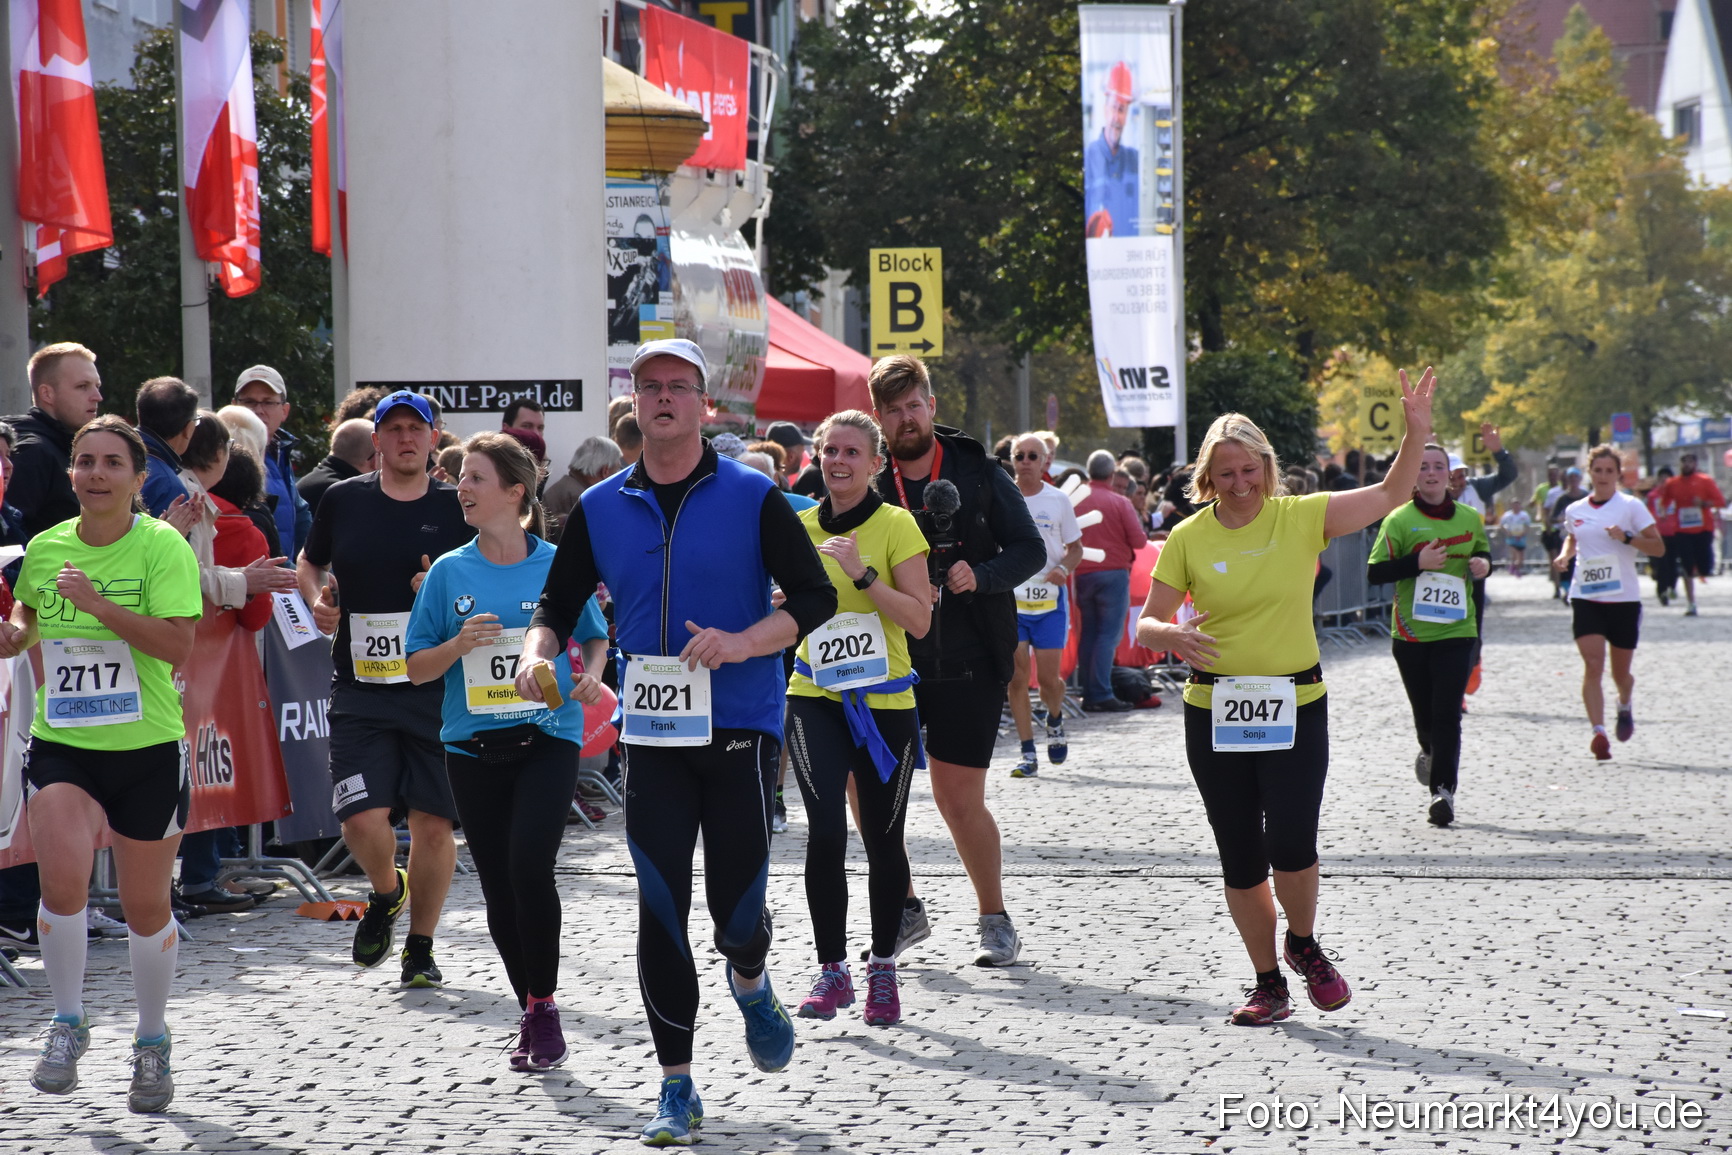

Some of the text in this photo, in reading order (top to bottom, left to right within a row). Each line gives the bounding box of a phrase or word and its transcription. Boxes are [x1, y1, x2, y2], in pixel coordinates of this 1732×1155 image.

[623, 251, 638, 264] CUP
[879, 253, 933, 272] Block
[889, 282, 925, 333] B
[1364, 386, 1395, 397] Block
[1369, 402, 1389, 431] C
[1583, 567, 1612, 582] 2607
[1025, 587, 1048, 600] 192
[1423, 587, 1460, 606] 2128
[366, 635, 401, 658] 291
[819, 632, 875, 664] 2202
[363, 660, 401, 673] HARALD
[651, 664, 682, 672] BOCK
[836, 666, 865, 677] Pamela
[56, 663, 121, 692] 2717
[634, 683, 691, 711] 2021
[56, 698, 133, 716] CHRISTINE
[1224, 699, 1284, 721] 2047
[651, 721, 676, 731] Frank
[1243, 730, 1266, 740] Sonja
[196, 723, 233, 786] Hits
[726, 740, 752, 752] asics
